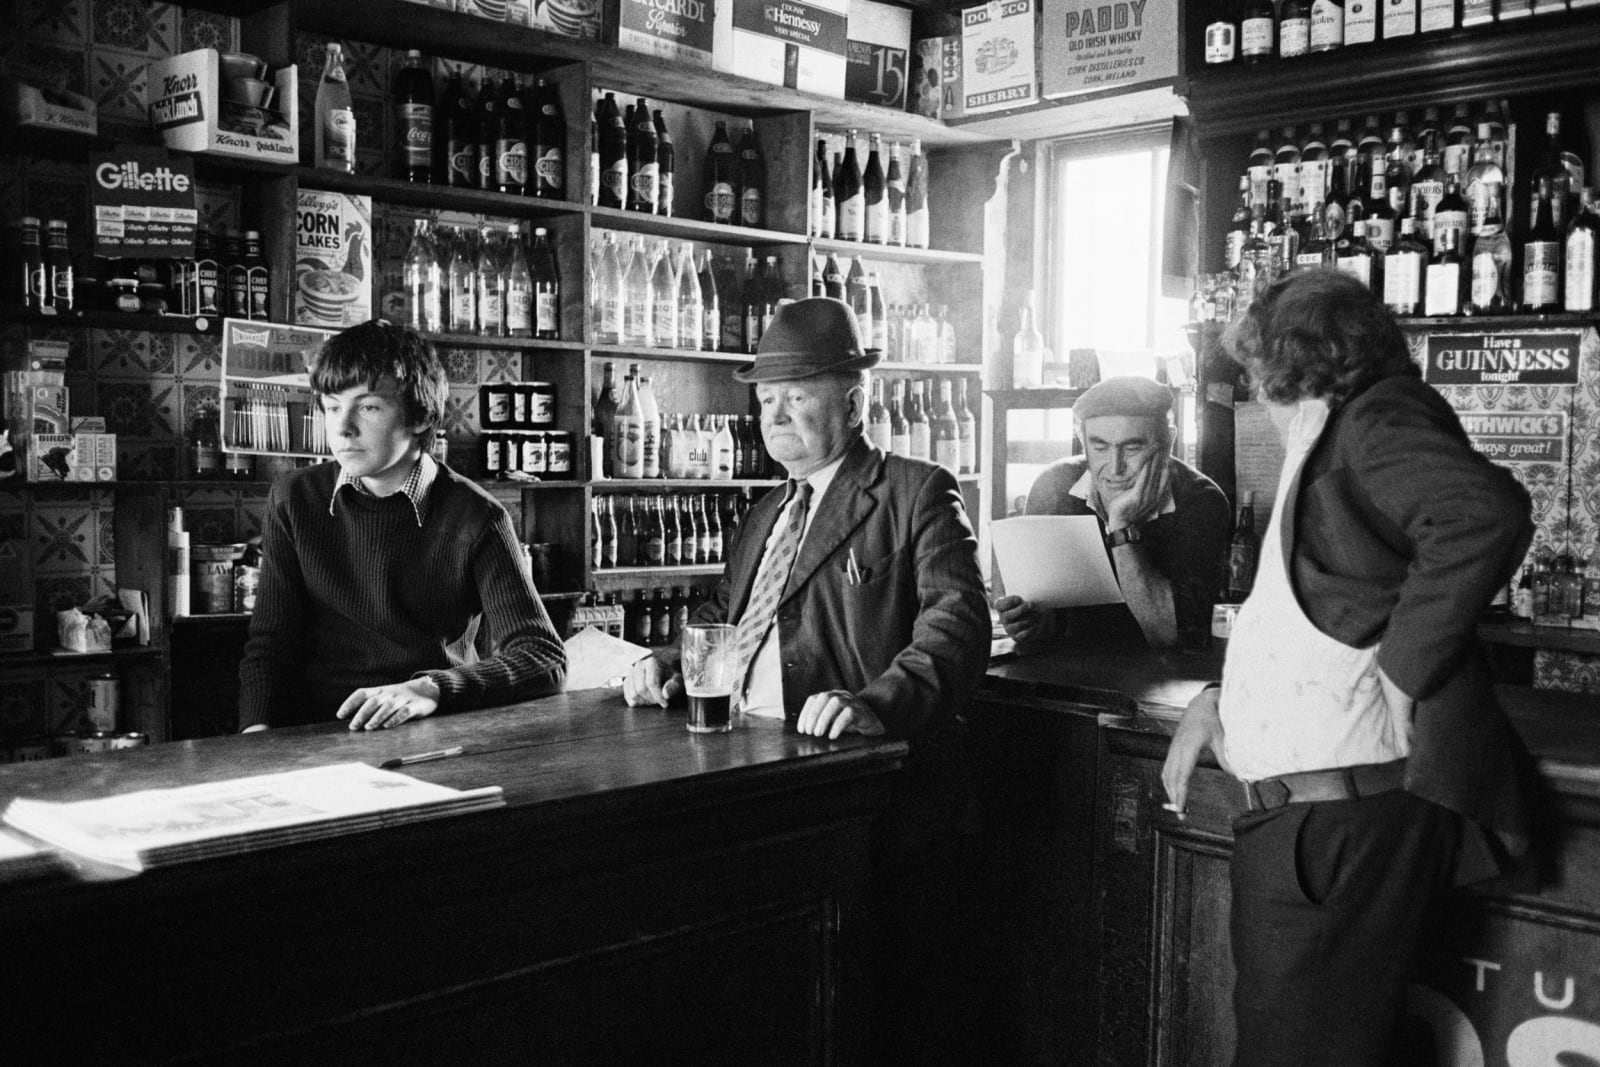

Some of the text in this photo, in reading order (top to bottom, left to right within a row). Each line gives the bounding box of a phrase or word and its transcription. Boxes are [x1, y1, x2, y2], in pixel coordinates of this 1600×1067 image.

[774, 8, 821, 36] Hennessy
[1066, 0, 1147, 38] PADDY
[1069, 29, 1143, 52] OLD IRISH WHISKY
[163, 73, 199, 96] Knorr
[868, 48, 905, 106] 15
[968, 86, 1028, 107] SHERRY
[216, 134, 251, 149] Knorr
[96, 161, 191, 193] Gillette
[200, 279, 218, 287] SAUCE
[1483, 336, 1522, 349] Have a
[1436, 348, 1570, 371] GUINNESS
[1481, 369, 1520, 383] tonight
[688, 448, 708, 463] club
